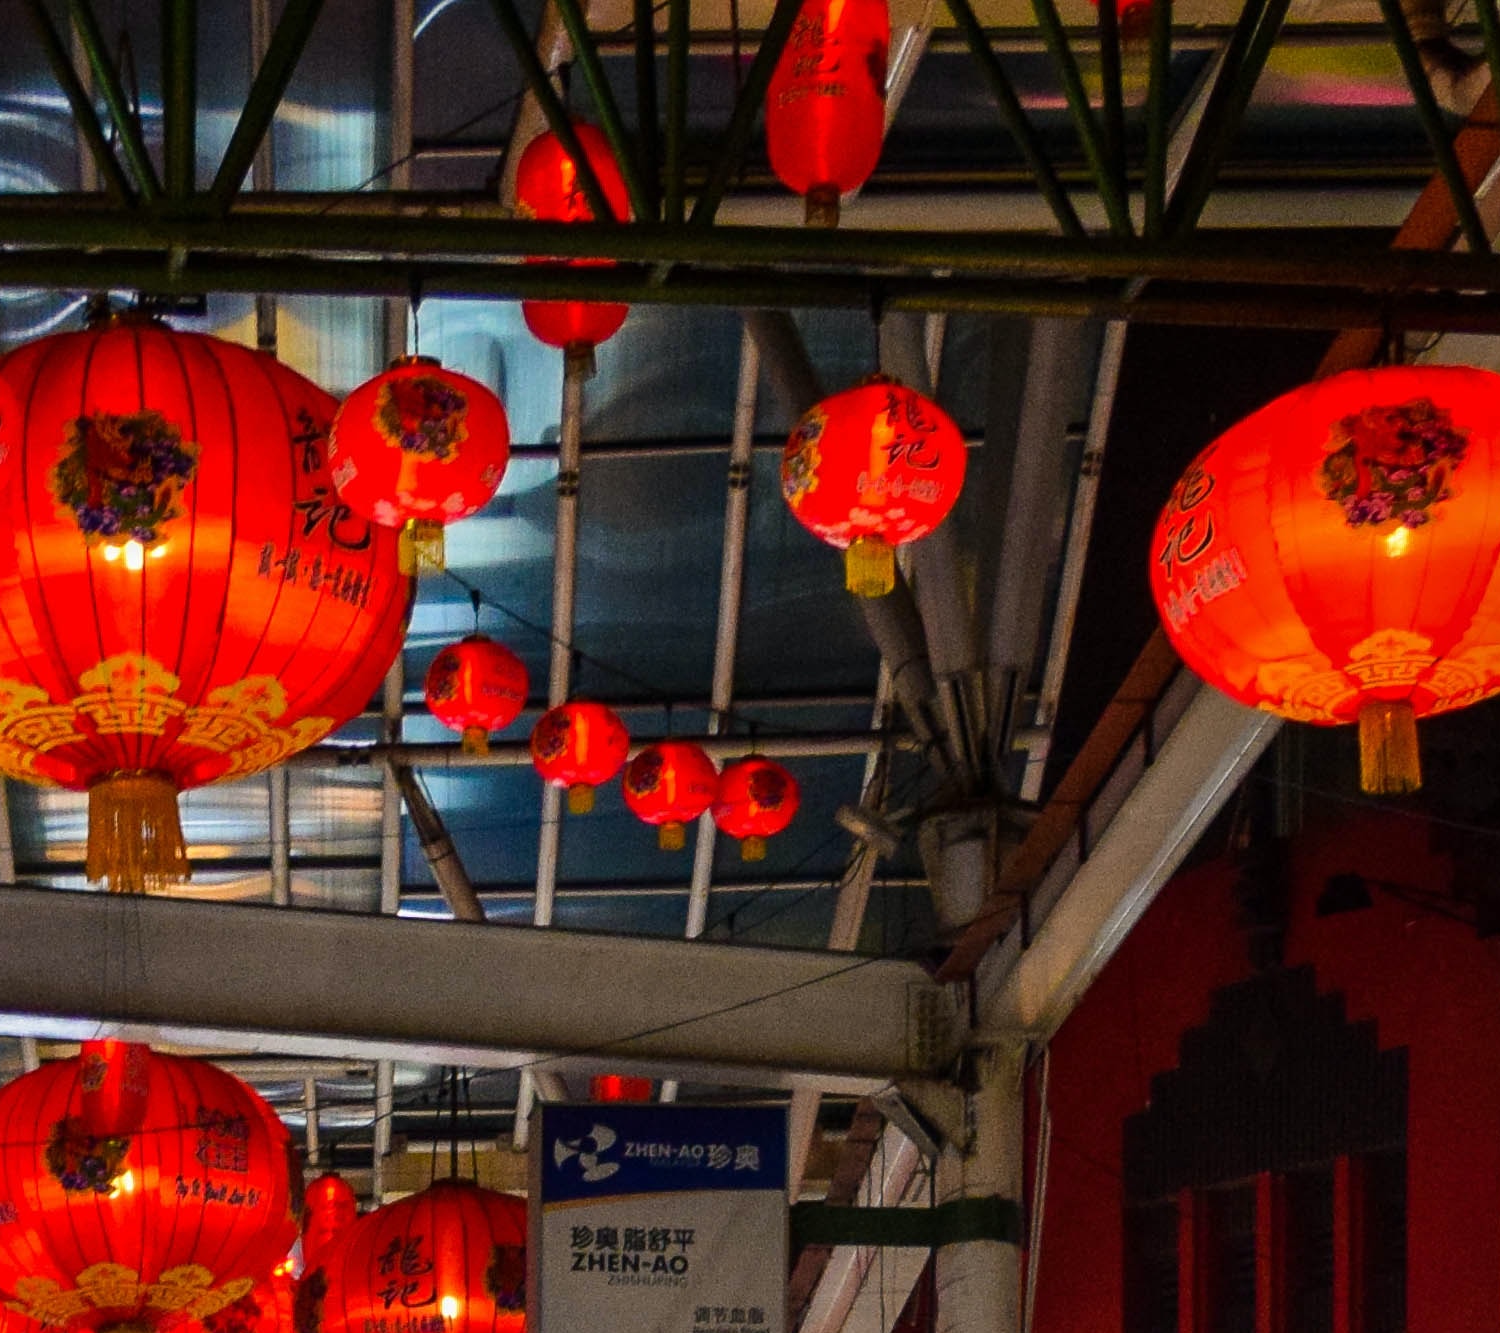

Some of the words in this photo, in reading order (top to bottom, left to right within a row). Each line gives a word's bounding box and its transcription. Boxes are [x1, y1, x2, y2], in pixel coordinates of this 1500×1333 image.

[625, 1142, 704, 1158] ZHEN-AO
[376, 1236, 437, 1310] 龍記
[571, 1253, 690, 1275] ZHEN-AO
